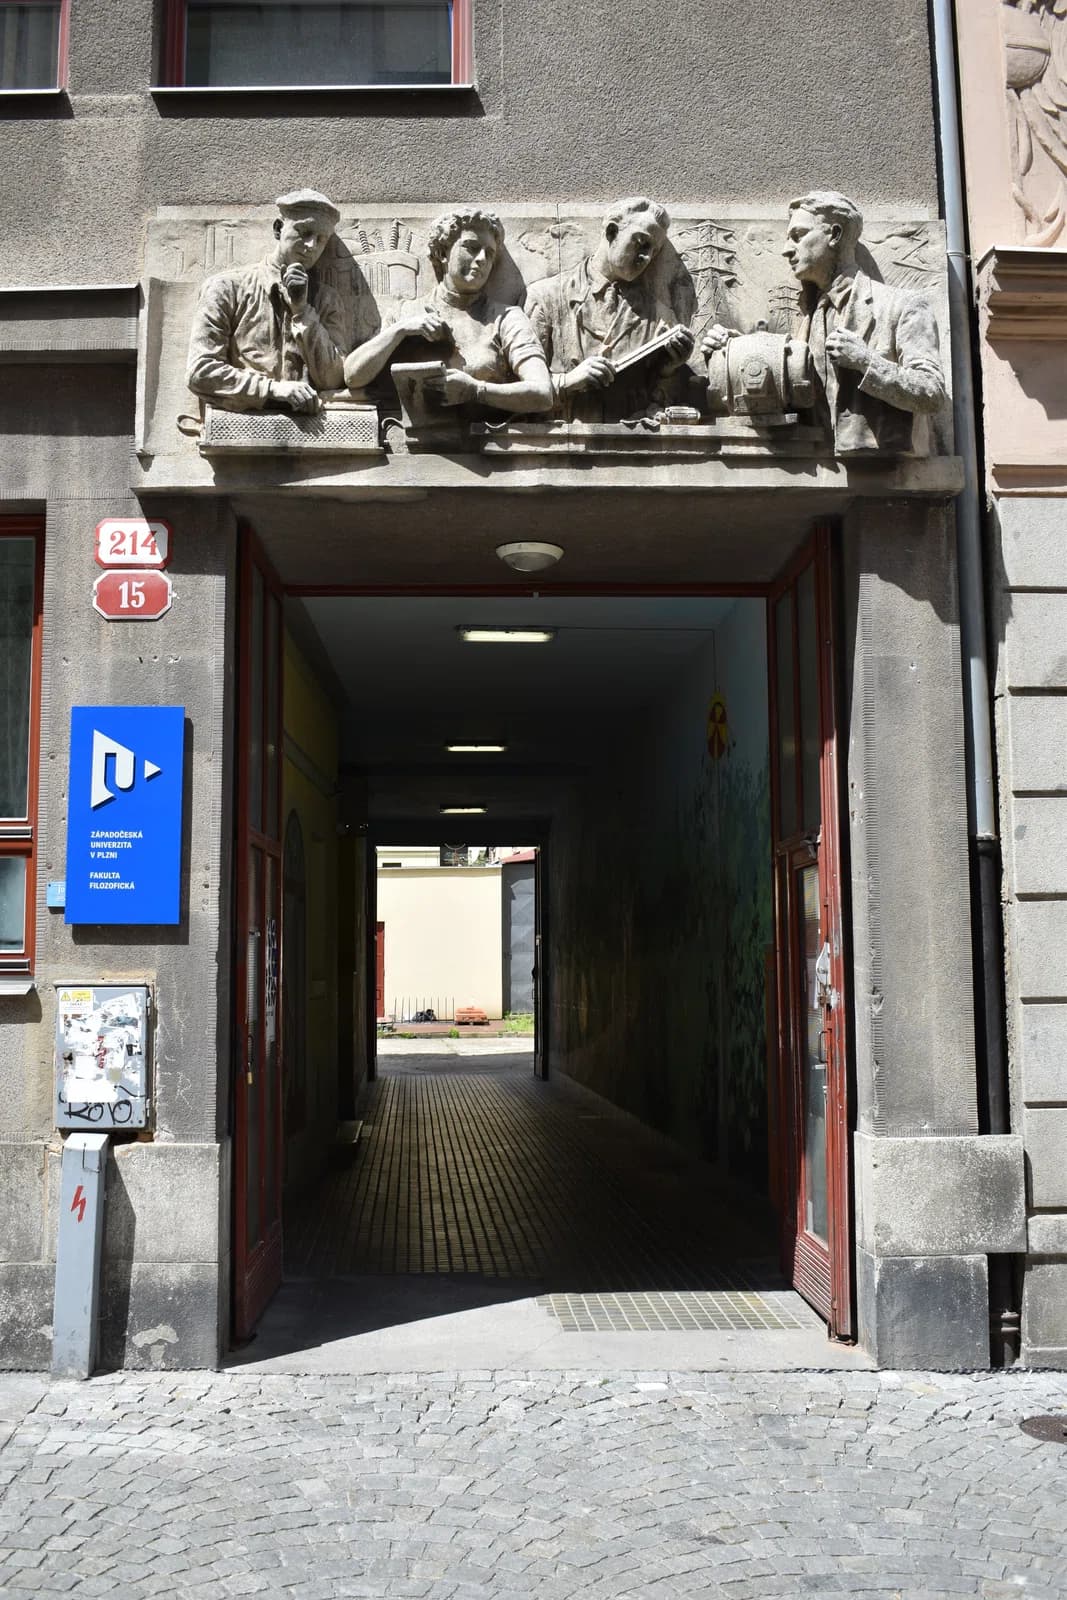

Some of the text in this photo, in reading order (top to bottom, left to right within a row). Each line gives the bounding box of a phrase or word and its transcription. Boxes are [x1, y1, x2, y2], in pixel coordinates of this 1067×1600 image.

[110, 530, 157, 556] 214
[118, 581, 146, 609] 15
[90, 830, 143, 839] ZÁPADOČESKÁ
[90, 841, 132, 849] UNIVERZITA
[90, 851, 118, 859] V PLZNI
[89, 881, 135, 890] FILOZOFICKÁ
